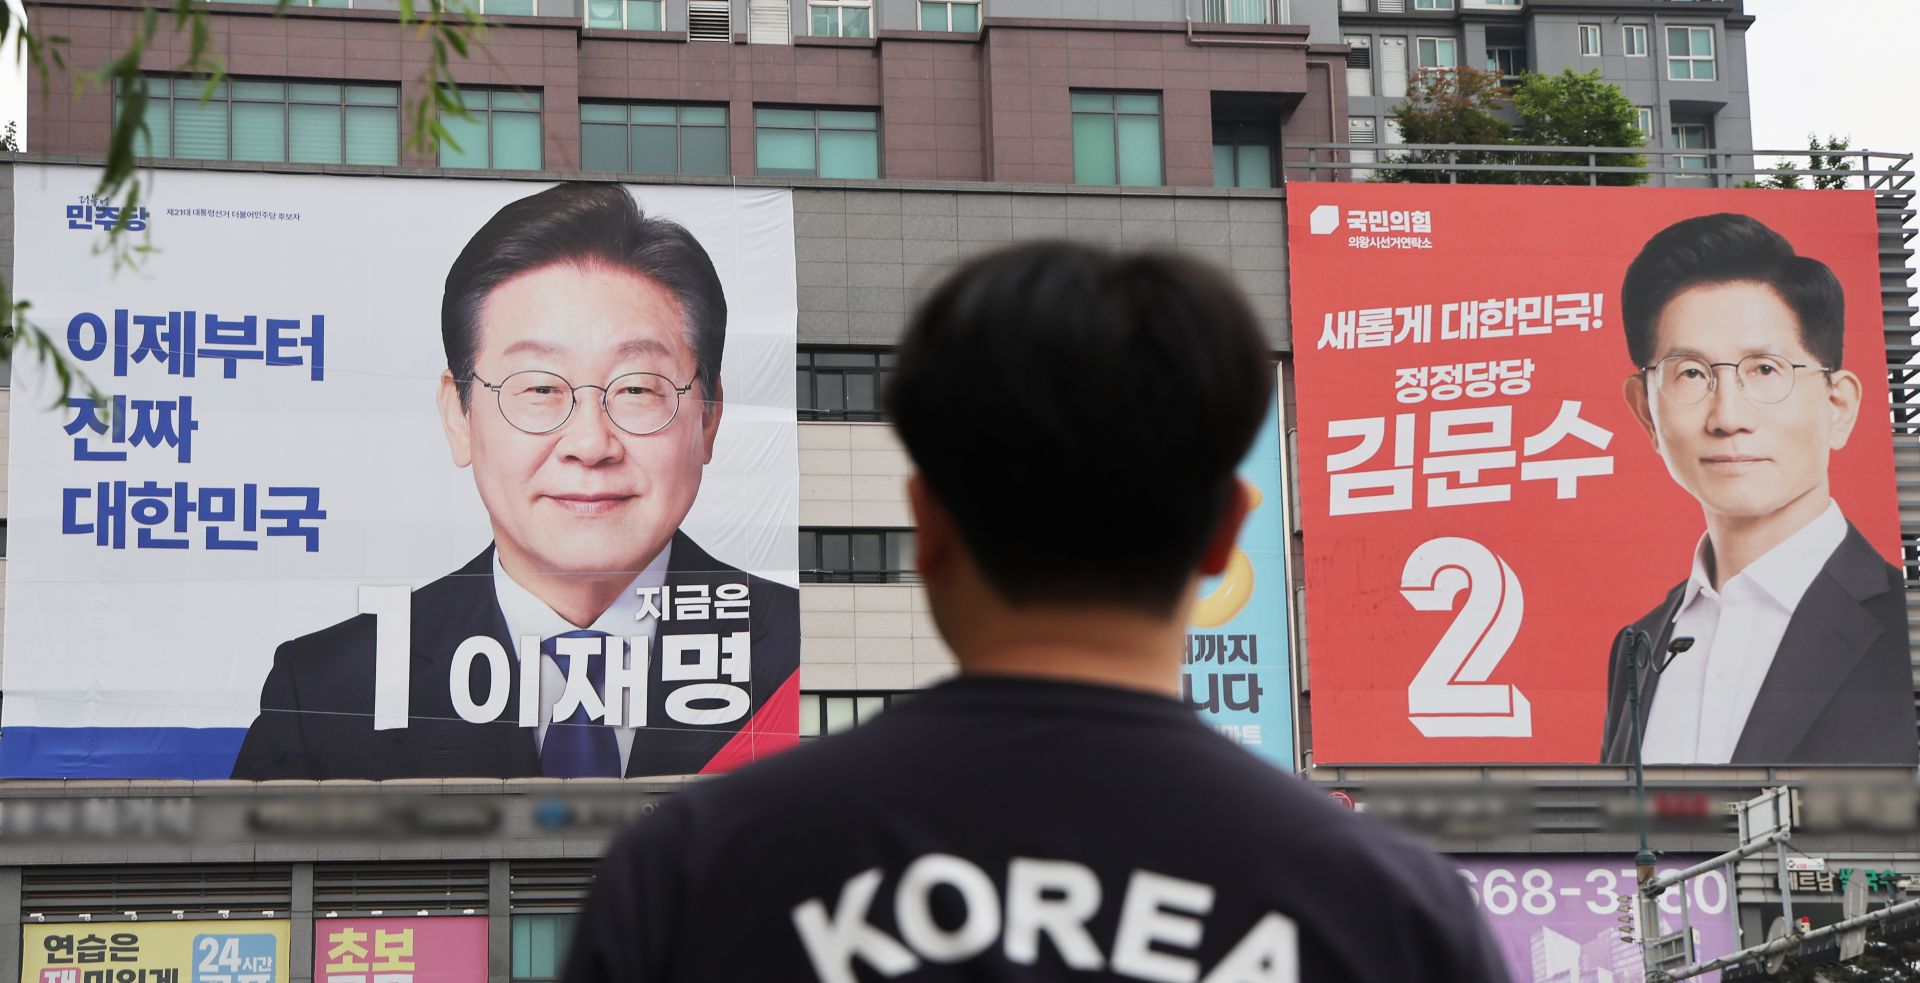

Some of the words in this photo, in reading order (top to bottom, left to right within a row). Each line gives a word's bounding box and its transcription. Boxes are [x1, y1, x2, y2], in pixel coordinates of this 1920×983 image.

[66, 205, 150, 232] 민주당
[166, 208, 192, 217] 제21대
[192, 208, 230, 219] 대통령선거
[231, 210, 276, 221] 더불어민주당
[278, 212, 300, 221] 후보자
[1347, 210, 1432, 234] 국민의힘
[1348, 236, 1433, 249] 의왕시선거연락소
[1317, 304, 1432, 350] 새롭게
[1441, 292, 1604, 340] 대한민국!
[66, 309, 325, 381] 이제부터
[1395, 358, 1535, 404] 정정당당
[63, 394, 199, 464] 진짜
[1327, 399, 1614, 517] 김문수
[62, 480, 327, 553] 대한민국
[635, 583, 751, 621] 지금은
[358, 585, 412, 730] 1
[1400, 536, 1532, 738] 2
[449, 631, 751, 728] 이재명
[1454, 868, 1728, 915] 68-380
[792, 853, 1303, 983] KOREA
[43, 933, 140, 963] 연습은
[199, 937, 272, 972] 24시간
[326, 928, 416, 973] 초보
